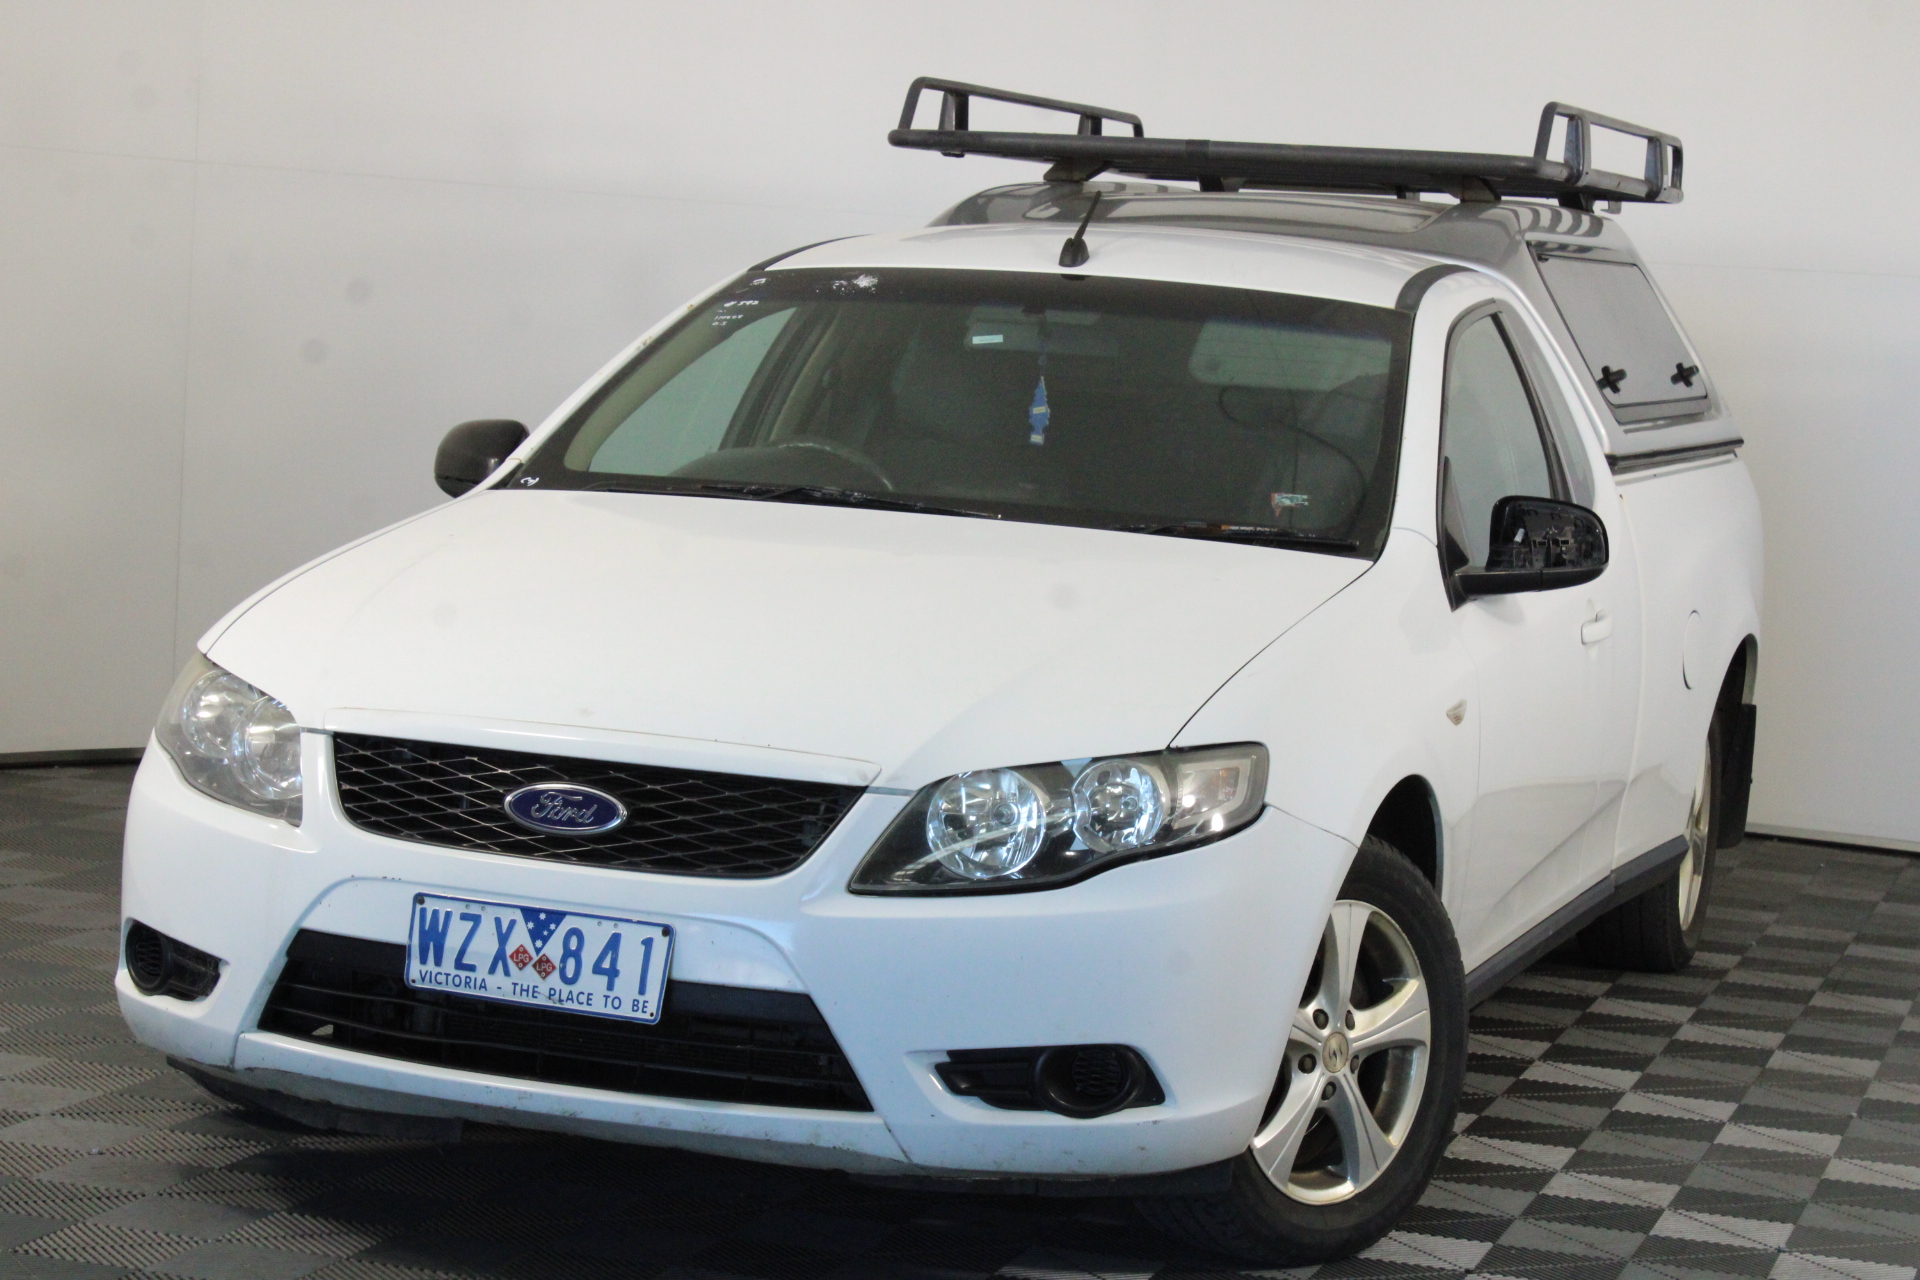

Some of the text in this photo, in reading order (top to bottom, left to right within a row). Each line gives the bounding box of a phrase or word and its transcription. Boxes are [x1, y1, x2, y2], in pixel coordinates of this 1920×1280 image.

[531, 791, 598, 824] Ford
[418, 906, 654, 996] WZX 841
[513, 952, 529, 962] LPG
[535, 962, 552, 972] LPG
[418, 970, 487, 992] VICTORIA
[511, 982, 540, 999] THE
[548, 987, 593, 1007] PLACE
[603, 995, 622, 1010] TO
[631, 999, 649, 1014] BE
